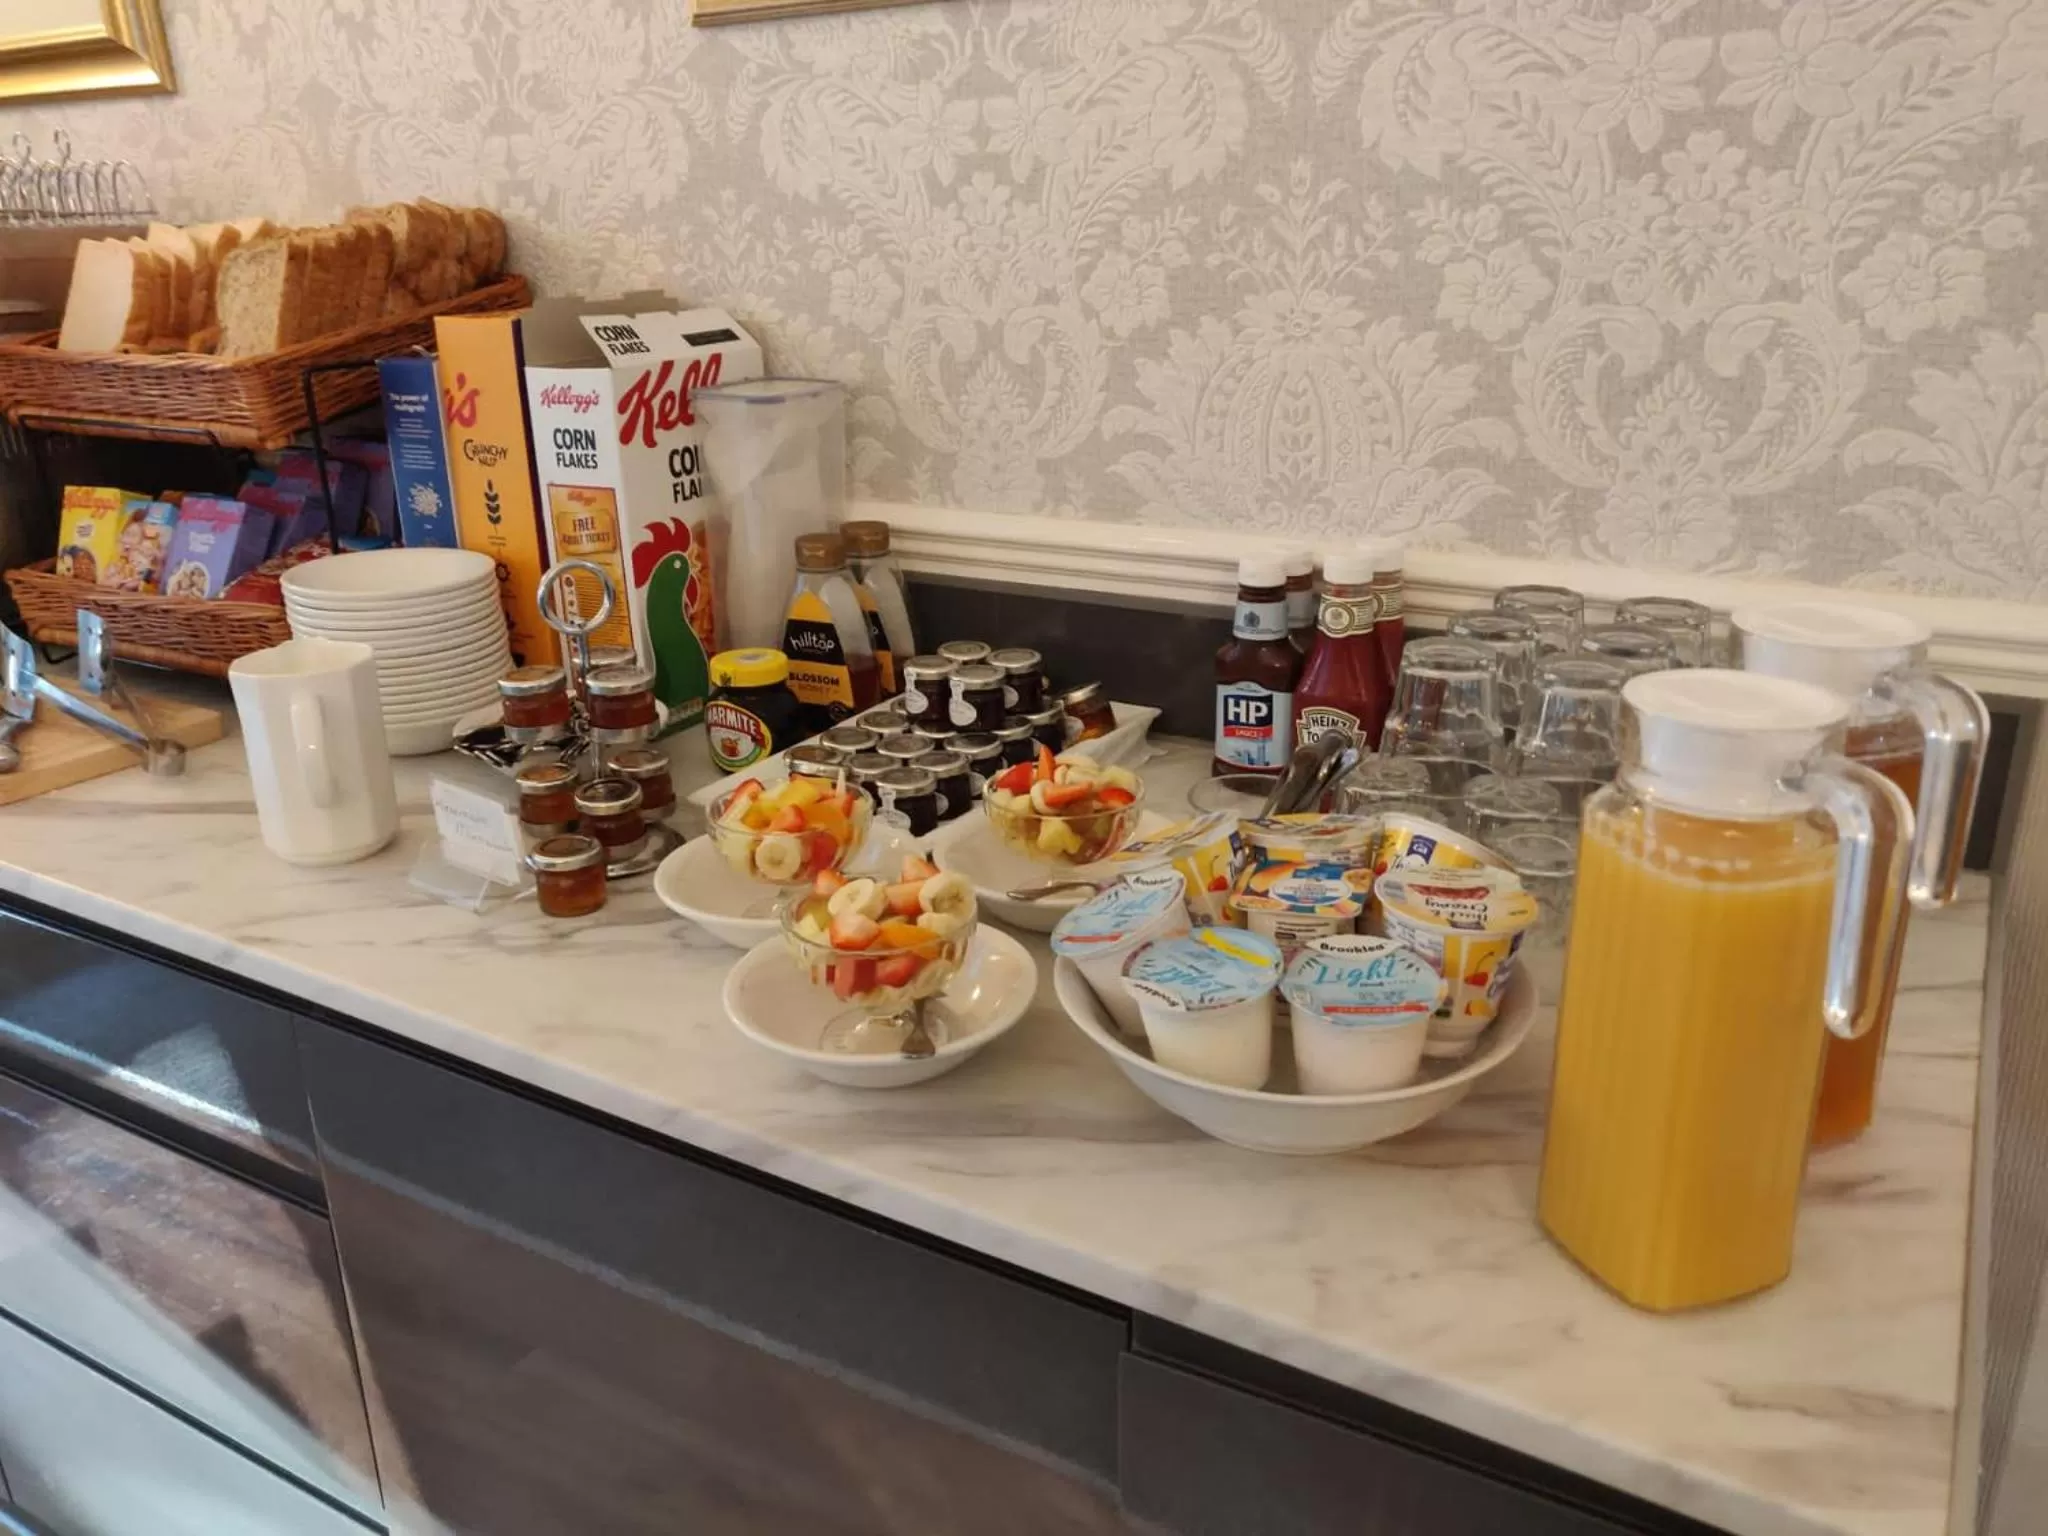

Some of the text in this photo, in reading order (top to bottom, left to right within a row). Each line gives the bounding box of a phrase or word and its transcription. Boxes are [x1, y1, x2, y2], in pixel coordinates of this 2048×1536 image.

[593, 324, 641, 342] CORN
[607, 341, 652, 356] FLAKES
[540, 384, 600, 413] Kellogg's
[553, 427, 597, 451] CORN
[556, 452, 598, 470] FLAKES
[668, 444, 700, 479] CO
[672, 478, 703, 504] FLA
[572, 516, 597, 532] FREE
[789, 631, 835, 652] hilltop
[789, 672, 840, 686] BLOSSOM
[1227, 698, 1268, 725] HP
[1313, 954, 1396, 988] Light
